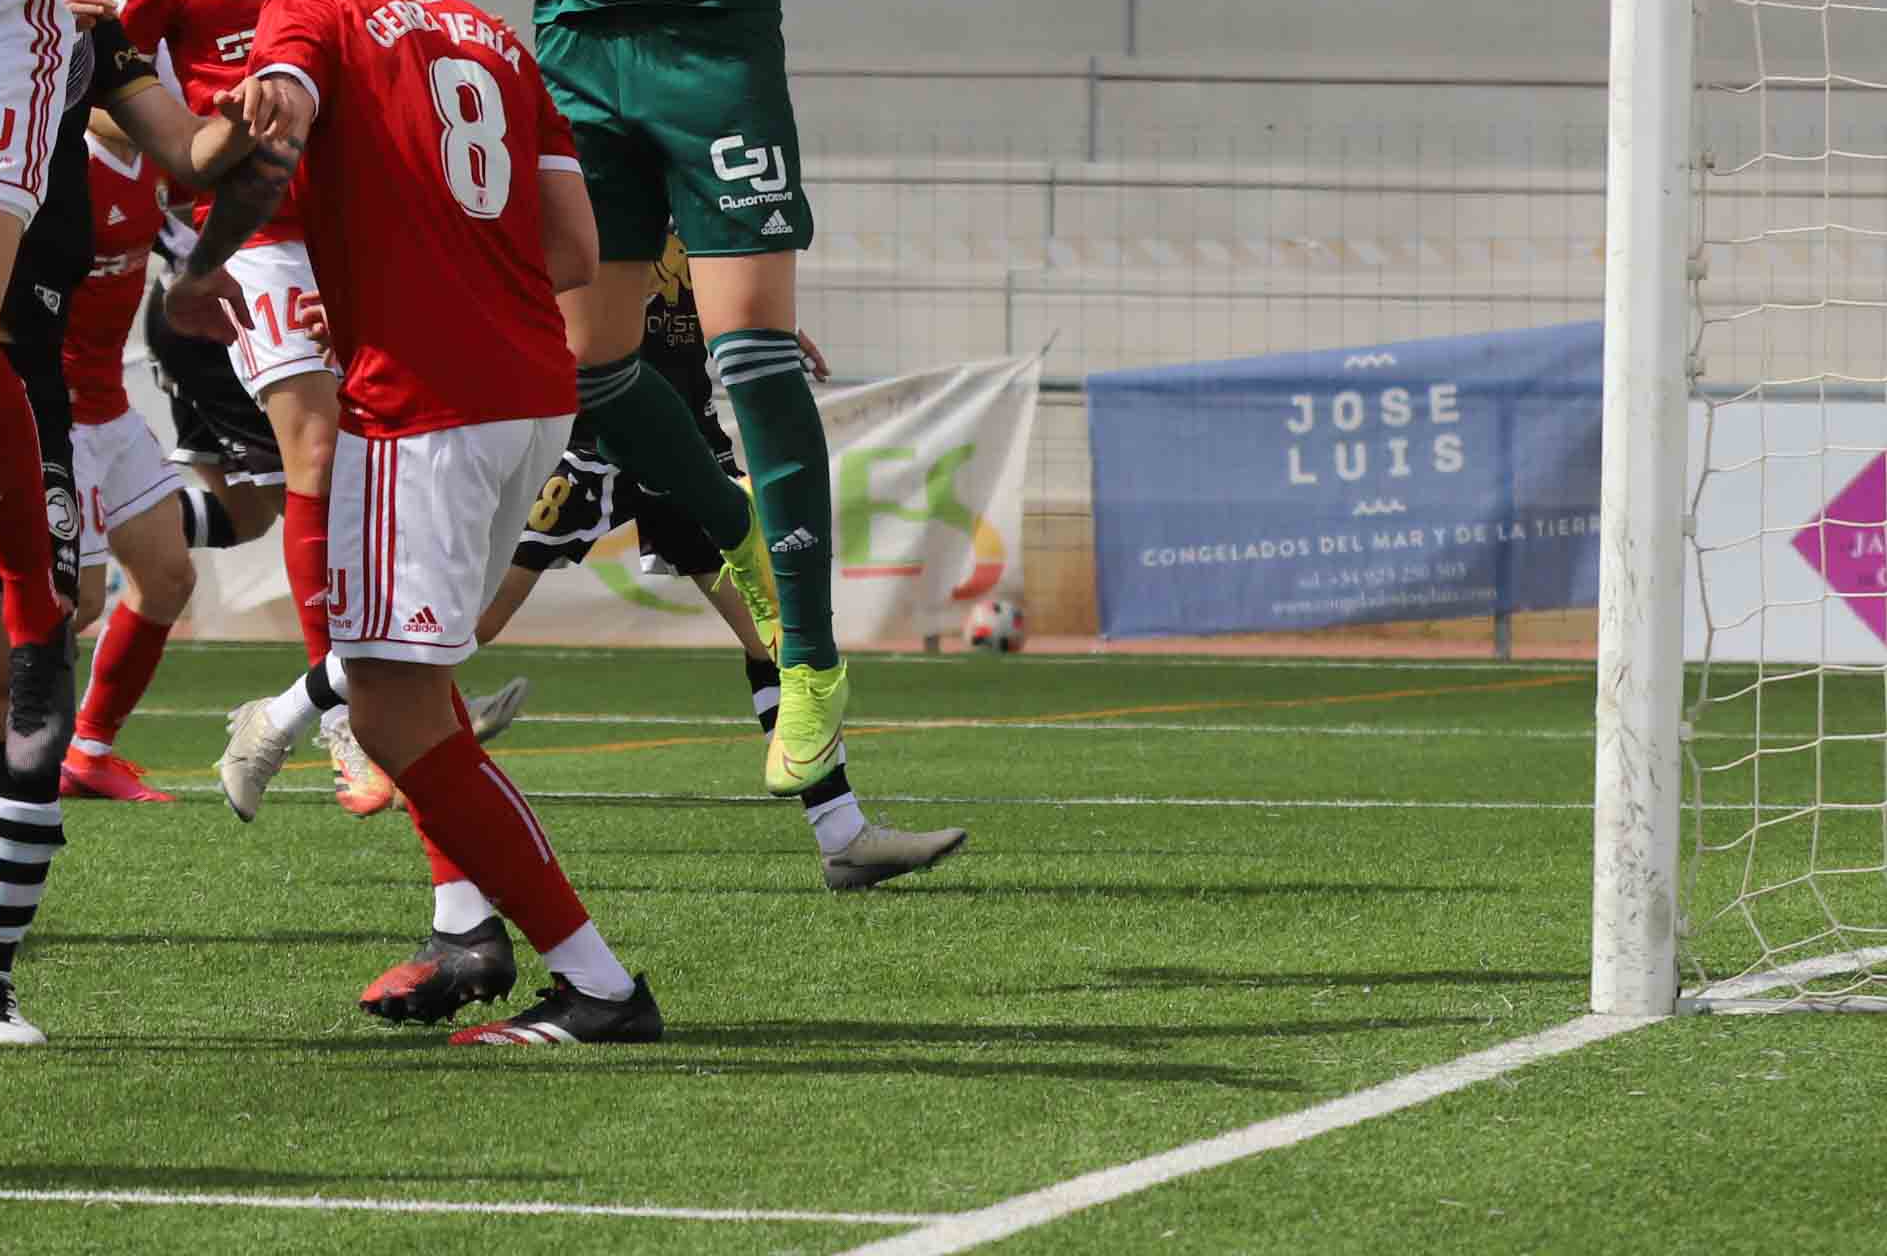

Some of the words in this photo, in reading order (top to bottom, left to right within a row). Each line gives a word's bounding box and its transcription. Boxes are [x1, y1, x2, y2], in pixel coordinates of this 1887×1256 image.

[428, 56, 512, 220] 8
[719, 191, 793, 212] Automotive
[761, 224, 793, 235] adidas
[1287, 384, 1460, 434] JOSE
[1288, 433, 1464, 486] LUIS
[1141, 538, 1312, 567] CONGELADOS
[1320, 534, 1364, 556] DEL
[1373, 529, 1424, 551] MAR
[1433, 527, 1449, 546] Y
[1456, 523, 1487, 544] DE
[1497, 520, 1526, 541] LA
[402, 623, 444, 634] adidas
